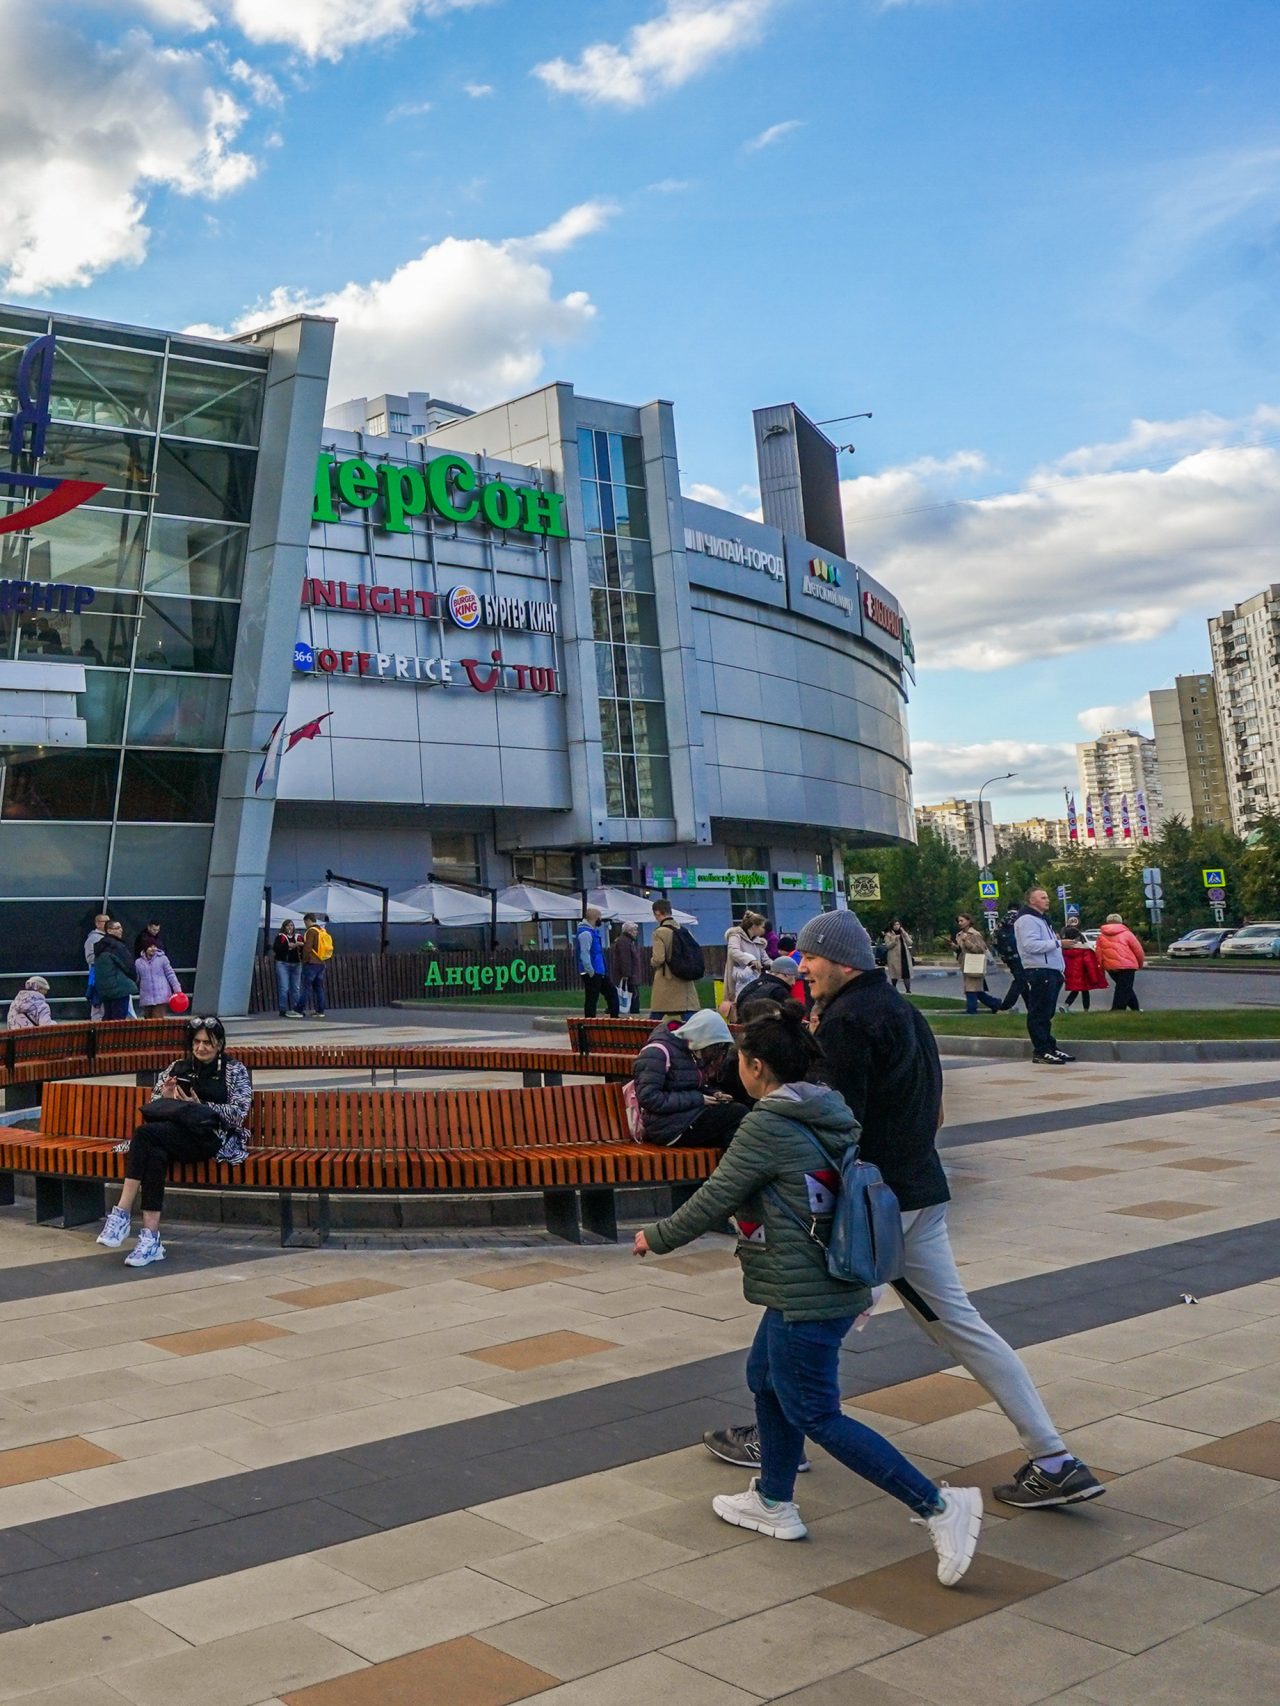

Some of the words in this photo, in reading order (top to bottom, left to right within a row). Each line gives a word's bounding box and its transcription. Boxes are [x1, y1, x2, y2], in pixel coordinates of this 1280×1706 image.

[453, 594, 476, 607] BURGER
[454, 601, 478, 617] KING
[483, 594, 525, 630] БУРГЕР
[528, 600, 558, 633] КИНГ
[512, 664, 556, 692] TUI
[424, 958, 557, 991] АндерСон
